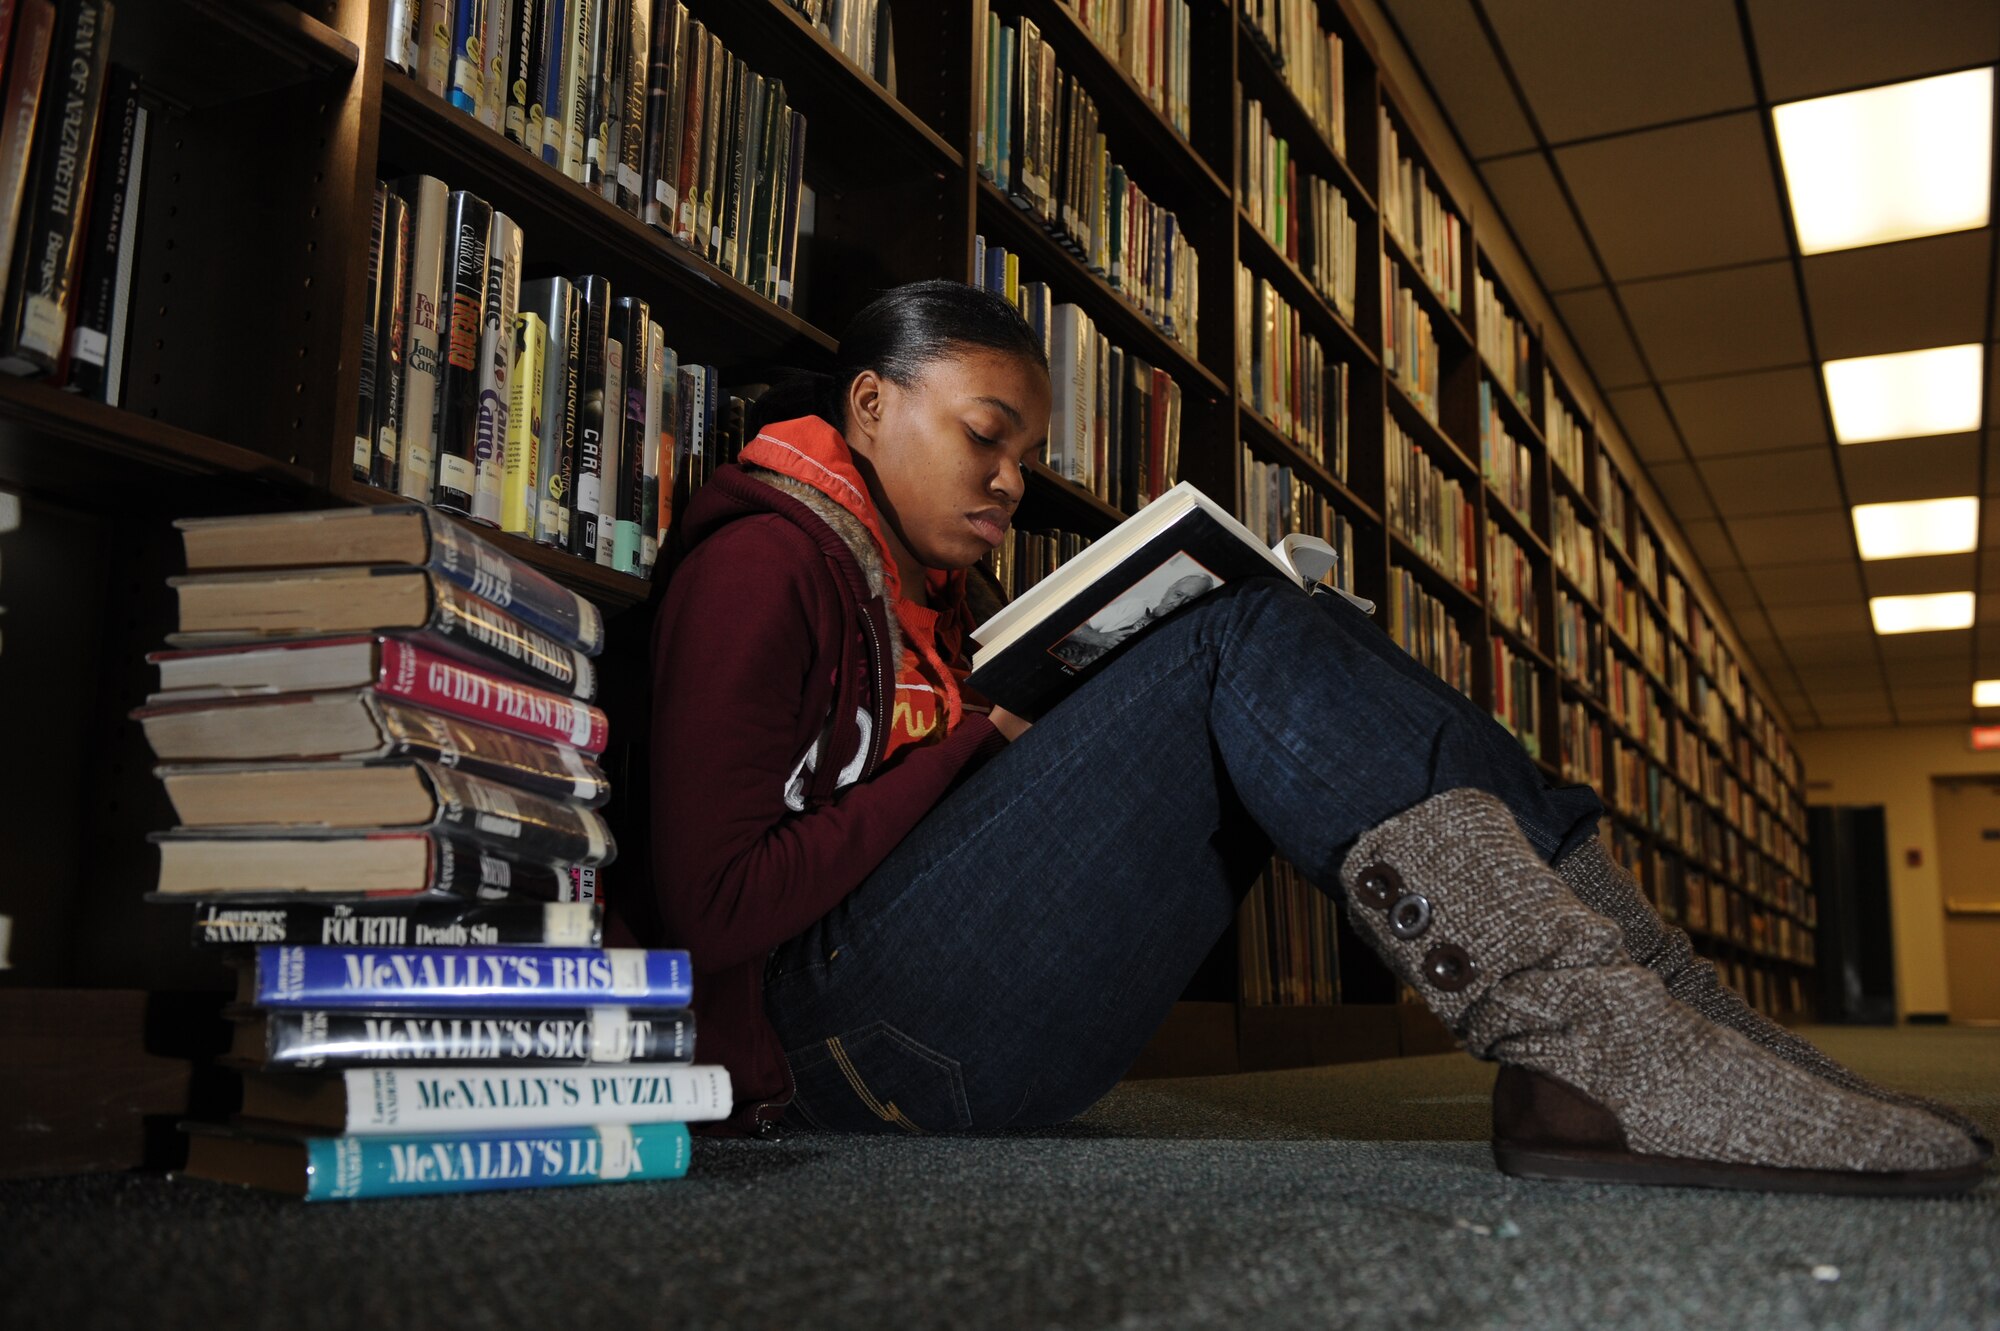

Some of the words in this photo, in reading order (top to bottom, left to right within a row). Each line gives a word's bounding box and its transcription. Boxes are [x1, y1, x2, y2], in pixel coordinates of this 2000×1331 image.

[71, 57, 90, 95] OF
[129, 80, 139, 91] A
[631, 60, 646, 121] CALEB
[51, 92, 85, 217] NAZARETH
[115, 97, 137, 187] CLOCKWORK
[105, 192, 125, 254] ORANGE
[458, 223, 475, 277] CARROLL
[449, 292, 482, 372] FIREBIRD
[634, 318, 645, 376] CARVER
[390, 369, 399, 415] James
[530, 439, 538, 467] MISS
[633, 430, 644, 484] DEAD
[470, 566, 513, 608] FILES
[428, 661, 491, 709] GUILTY
[204, 922, 287, 942] SANDERS
[207, 906, 288, 926] Lawrence
[321, 916, 407, 945] FOURTH
[415, 922, 468, 946] Deadly
[470, 923, 499, 945] Sin
[333, 904, 354, 918] The
[341, 954, 540, 991] McNALLY'S
[361, 1019, 532, 1059] McNALLY'S
[536, 1020, 653, 1059] SECT
[416, 1076, 581, 1110] McNALLY'S
[388, 1137, 565, 1184] McNALLY'S
[567, 1137, 644, 1176] LUK
